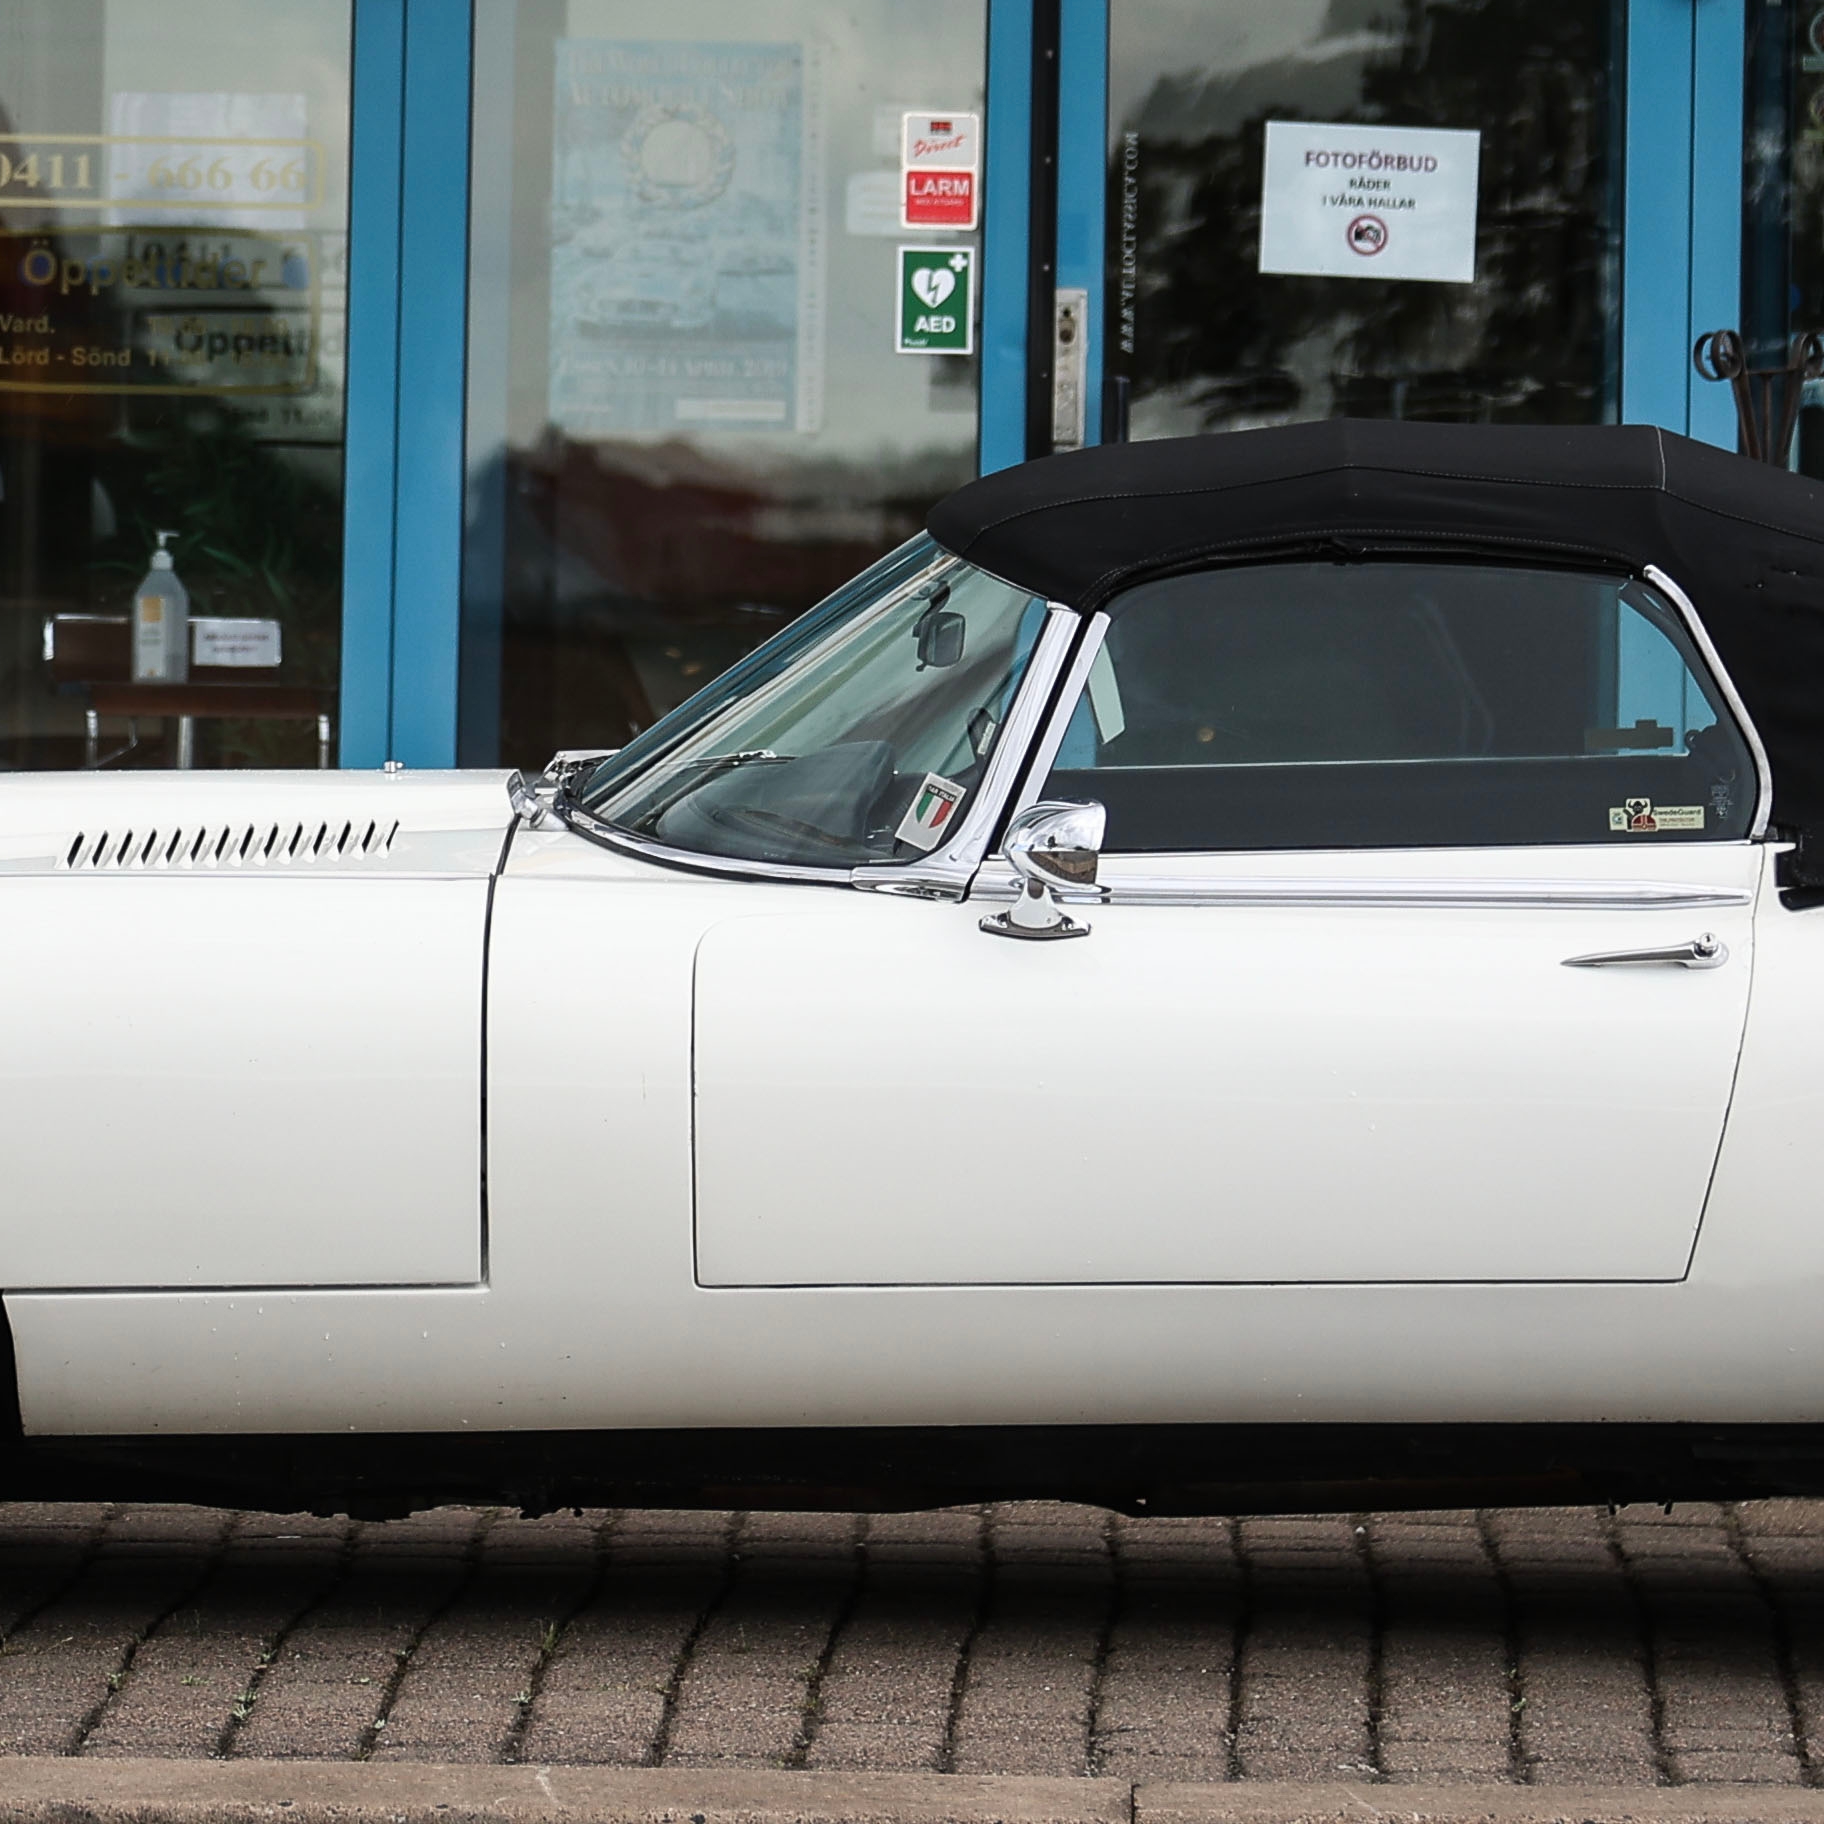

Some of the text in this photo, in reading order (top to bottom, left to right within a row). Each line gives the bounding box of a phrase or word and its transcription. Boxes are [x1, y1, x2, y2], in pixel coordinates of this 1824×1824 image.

[913, 134, 967, 158] Direct
[1304, 149, 1438, 173] FOTOFÖRBUD
[147, 155, 234, 192] 666
[249, 156, 306, 193] 66
[909, 179, 970, 196] LARM
[1367, 196, 1416, 210] HALLAR
[23, 240, 268, 296] Öppettider
[914, 315, 956, 333] AED
[71, 345, 132, 368] Sönd
